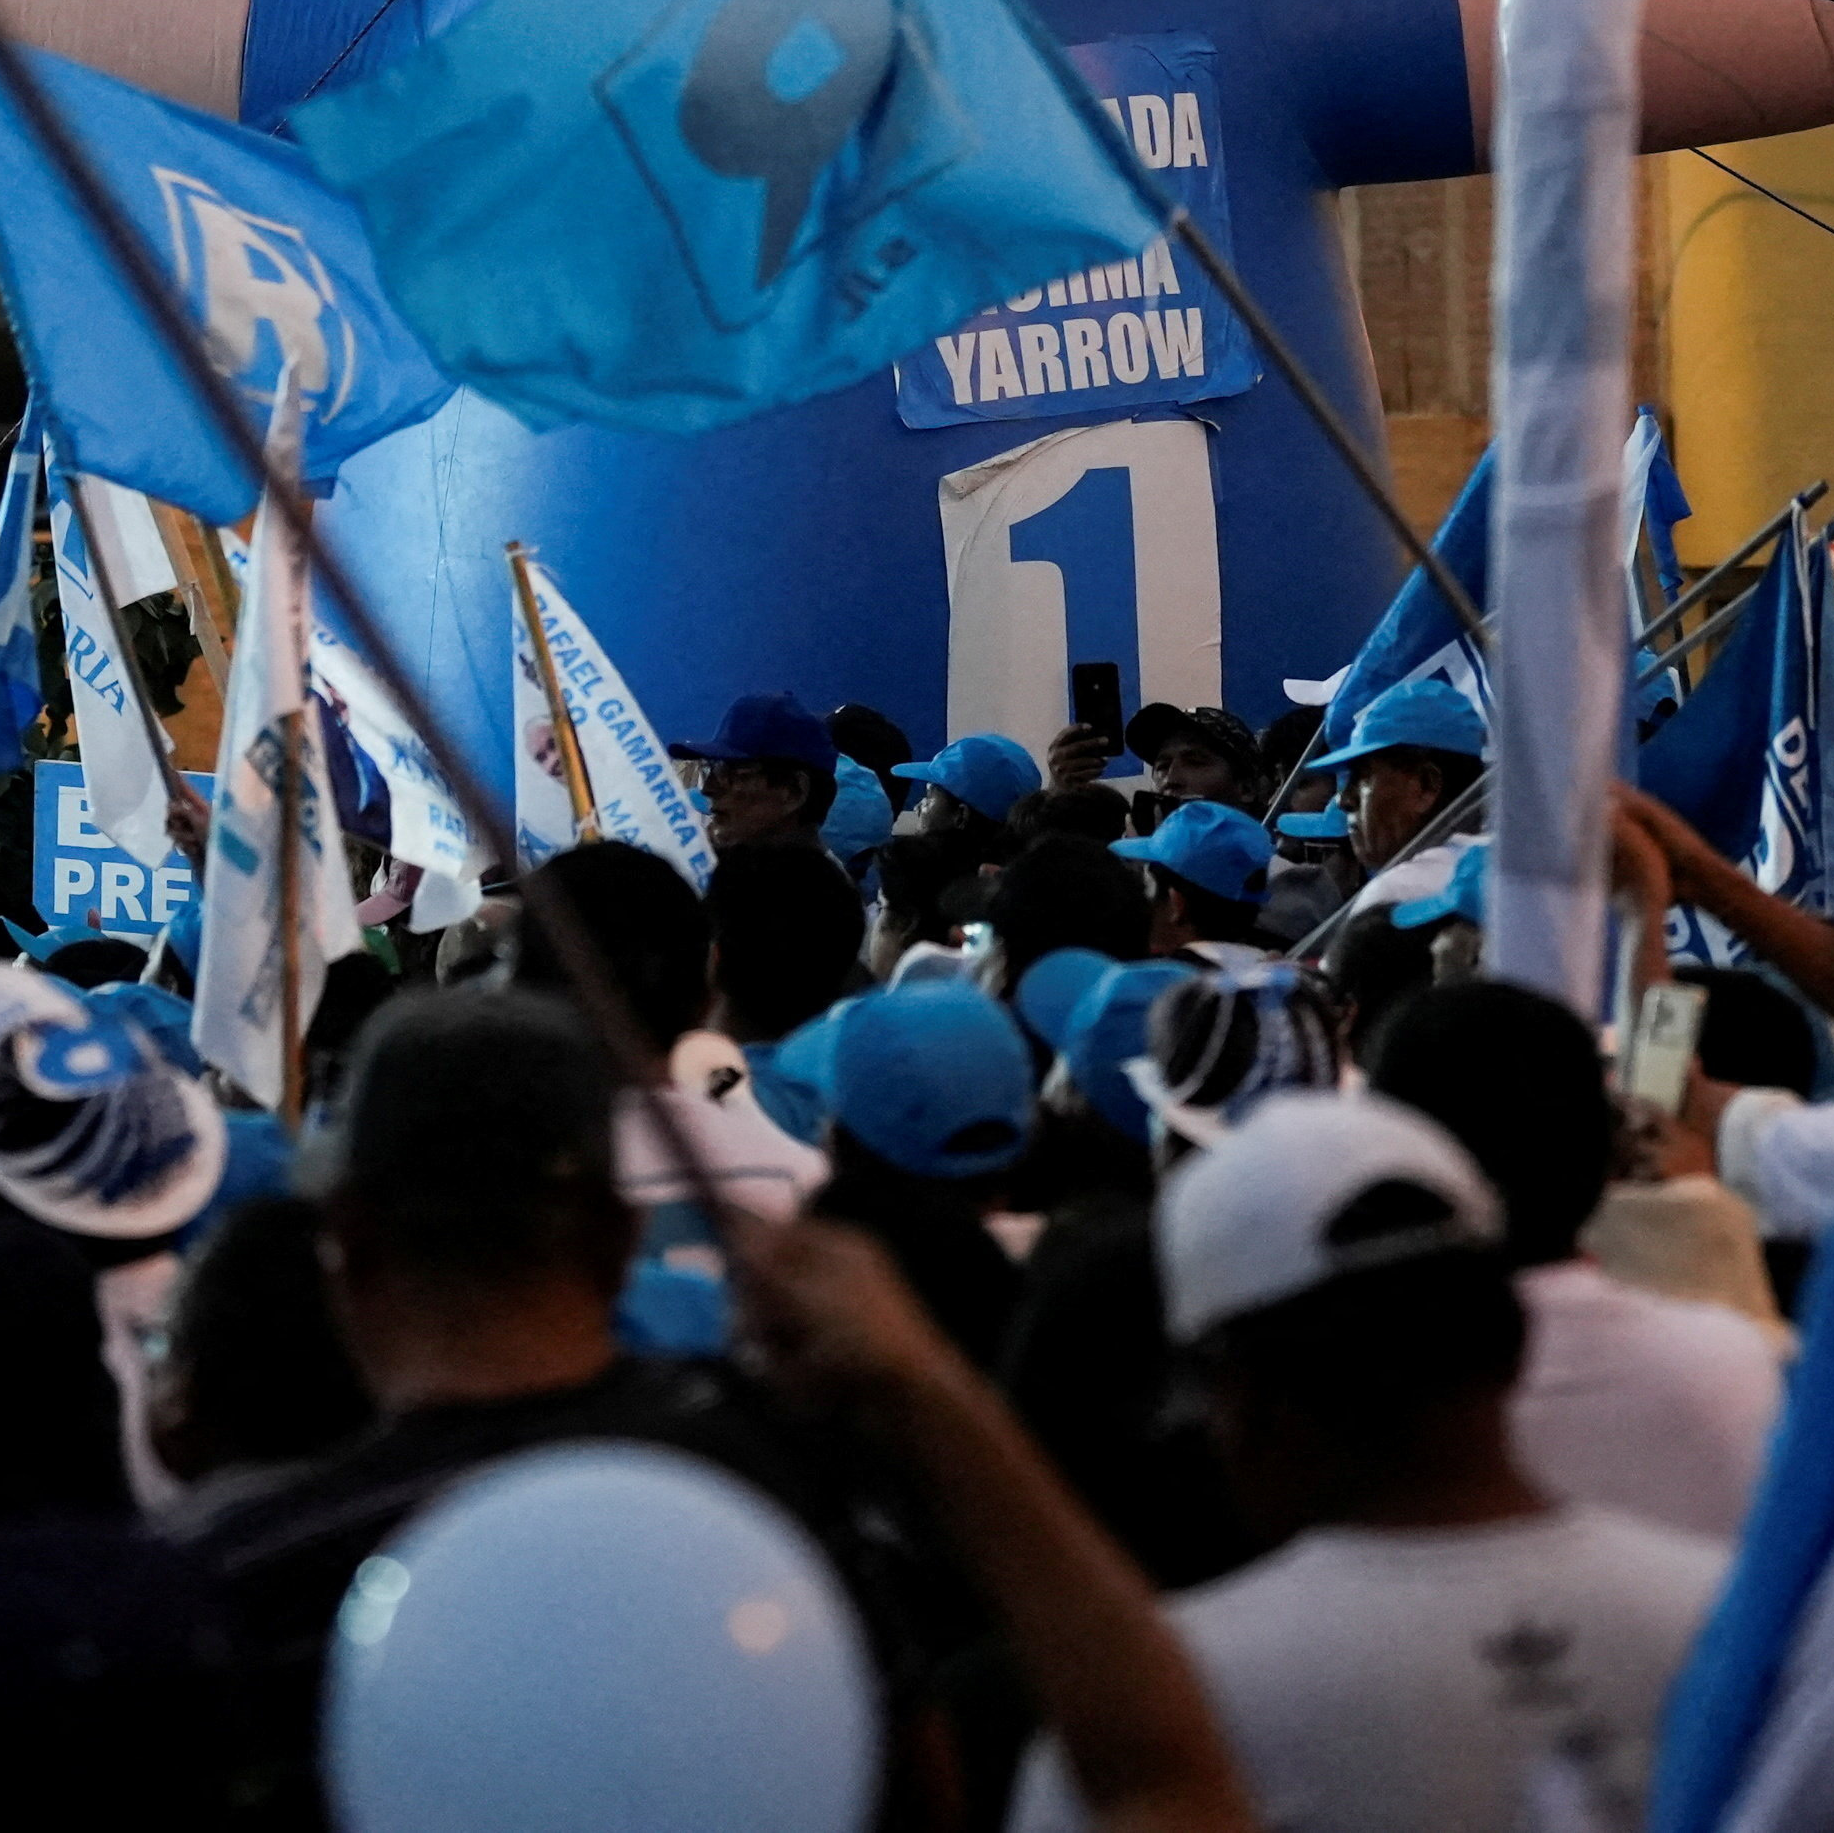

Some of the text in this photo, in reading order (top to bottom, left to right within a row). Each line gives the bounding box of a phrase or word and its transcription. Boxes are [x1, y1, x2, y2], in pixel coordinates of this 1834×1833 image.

[187, 194, 329, 394] R
[935, 307, 1205, 405] YARROW
[64, 611, 125, 718] RIA
[1009, 466, 1144, 741] 1
[596, 698, 698, 849] GAMARRA
